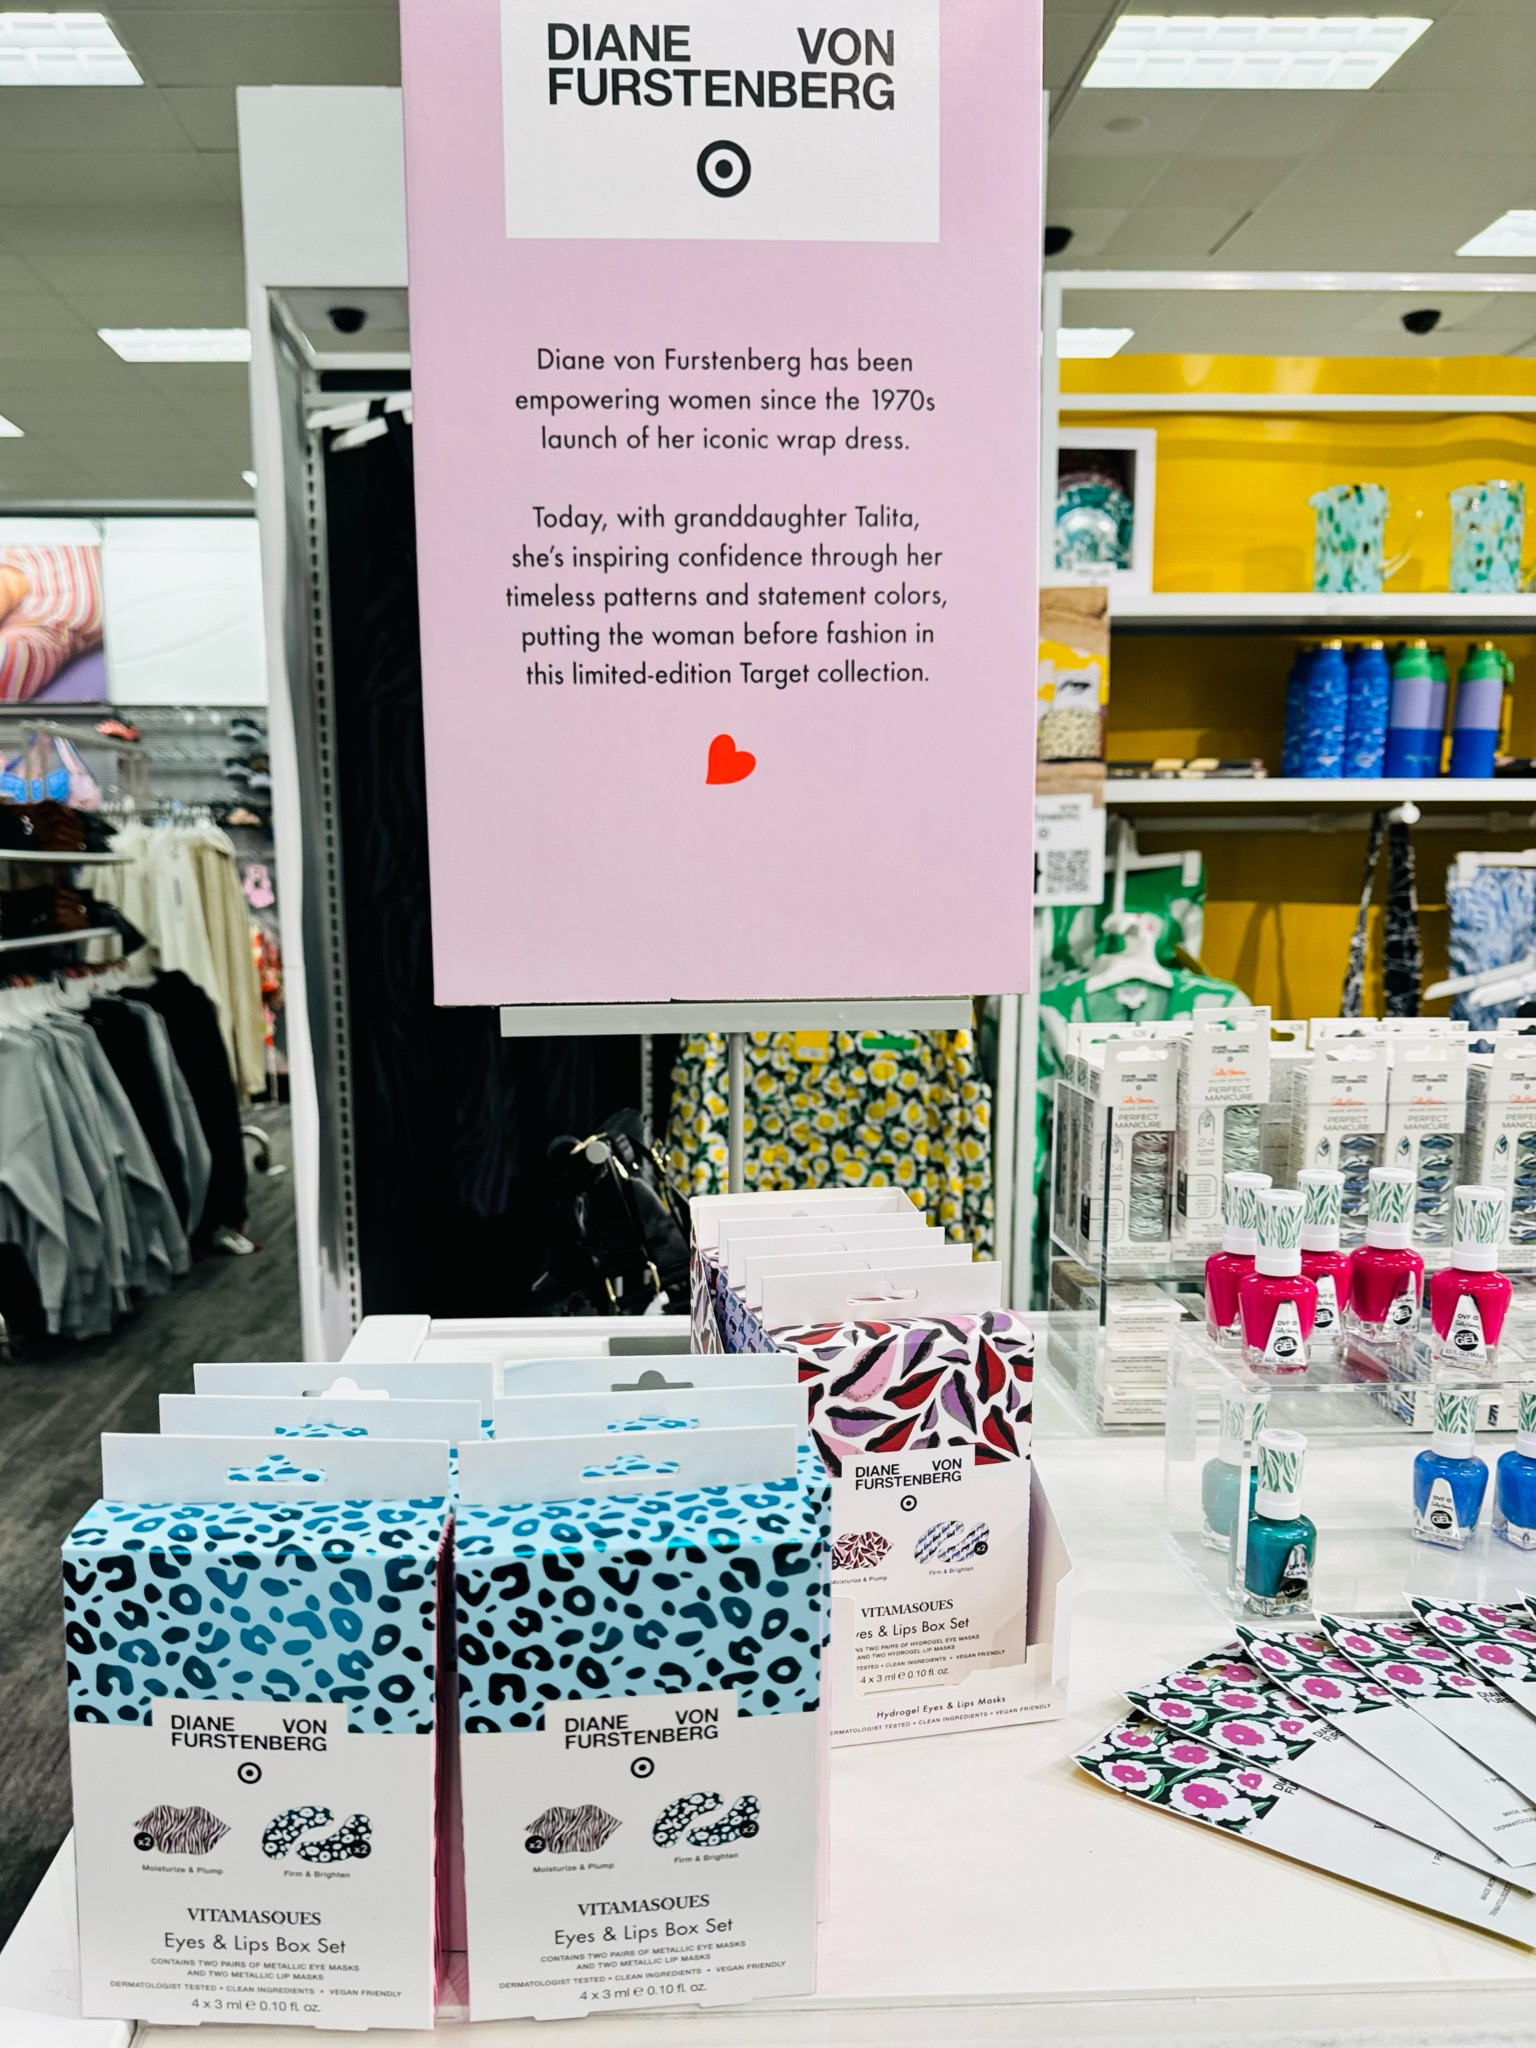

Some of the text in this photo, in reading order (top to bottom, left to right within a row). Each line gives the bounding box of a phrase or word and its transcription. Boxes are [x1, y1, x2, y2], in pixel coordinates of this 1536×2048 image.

[547, 22, 894, 67] DIANE VON
[548, 67, 895, 111] FURSTENBERG
[537, 346, 913, 378] Diane von Furstenberg has been
[515, 386, 936, 417] empowering women since the 1970s
[541, 424, 910, 456] launch of her iconic wrap dress.
[532, 503, 919, 535] Today, with granddaughter Talita,
[512, 542, 943, 574] she's inspiring confidence through her
[506, 581, 947, 614] timeless patterns and statement colors,
[522, 620, 934, 653] putting the woman before fashion in
[526, 659, 929, 690] this limited-edition Target collection.
[1204, 1092, 1255, 1102] MANICURE
[1208, 1085, 1251, 1094] PERFECT
[1114, 1121, 1162, 1129] MANICURE
[1118, 1113, 1160, 1121] PERFECT
[1403, 1122, 1451, 1130] MANICURE
[1407, 1114, 1448, 1123] PERFECT
[1274, 1342, 1298, 1353] GEL
[1454, 1334, 1480, 1346] GEL
[854, 1457, 963, 1479] DIANE VON
[854, 1470, 963, 1492] FURSTENBERG
[1431, 1515, 1453, 1524] GEL
[861, 1598, 954, 1618] VITAMASQUES
[878, 1624, 888, 1638] &
[893, 1623, 918, 1638] Lips
[922, 1620, 946, 1633] Box
[949, 1616, 970, 1630] Set
[876, 1695, 1006, 1720] Hydrogel Eyes & Lips Masks
[884, 1721, 911, 1729] TESTED
[918, 1717, 941, 1726] CLEAN
[942, 1711, 988, 1722] INGREDIENTS
[995, 1707, 1018, 1716] VEGAN
[1019, 1703, 1052, 1712] FRIENDLY
[170, 1714, 327, 1735] DIANE VON
[565, 1707, 720, 1733] DIANE VON
[171, 1731, 327, 1752] FURSTENBERG
[565, 1724, 720, 1750] FURSTENBERG
[138, 1836, 151, 1847] x2
[354, 1845, 367, 1854] x2
[532, 1865, 578, 1873] Moisturize
[587, 1862, 615, 1870] Plump
[674, 1856, 693, 1864] Firm
[702, 1852, 739, 1862] Brighten
[142, 1864, 186, 1873] Moisturize
[196, 1866, 224, 1876] Plump
[283, 1869, 304, 1877] Firm
[313, 1870, 351, 1880] Brighten
[577, 1894, 710, 1916] VITAMASQUES
[187, 1907, 322, 1926] VITAMASQUES
[554, 1917, 734, 1949] Eyes & Lips Box Set
[164, 1932, 346, 1956] Eyes & Lips Box Set
[540, 1953, 585, 1963] CONTAINS
[610, 1950, 636, 1958] PAIRS
[637, 1948, 650, 1956] OF
[652, 1945, 694, 1955] METALLIC
[696, 1943, 713, 1951] EYE
[715, 1940, 746, 1949] MASKS
[150, 1957, 360, 1972] CONTAINS TWO PAIRS OF METALLIC EYE MASKS
[576, 1953, 711, 1970] AND TWO METALLIC LIP MASKS
[187, 1969, 324, 1981] AND TWO METALLIC LIP MASKS
[498, 1960, 786, 1989] DERMATOLOGIST TESTED CLEAN INGREDIENTS VEGAN FRIENDLY
[110, 1980, 402, 1998] DERMATOLOGIST TESTED CLEAN INGREDIENTS VEGAN FRIENDLY
[191, 1998, 200, 2008] 4
[203, 2000, 212, 2009] x
[214, 1998, 224, 2010] 3
[226, 1999, 242, 2010] ml
[259, 2000, 288, 2012] 0.10
